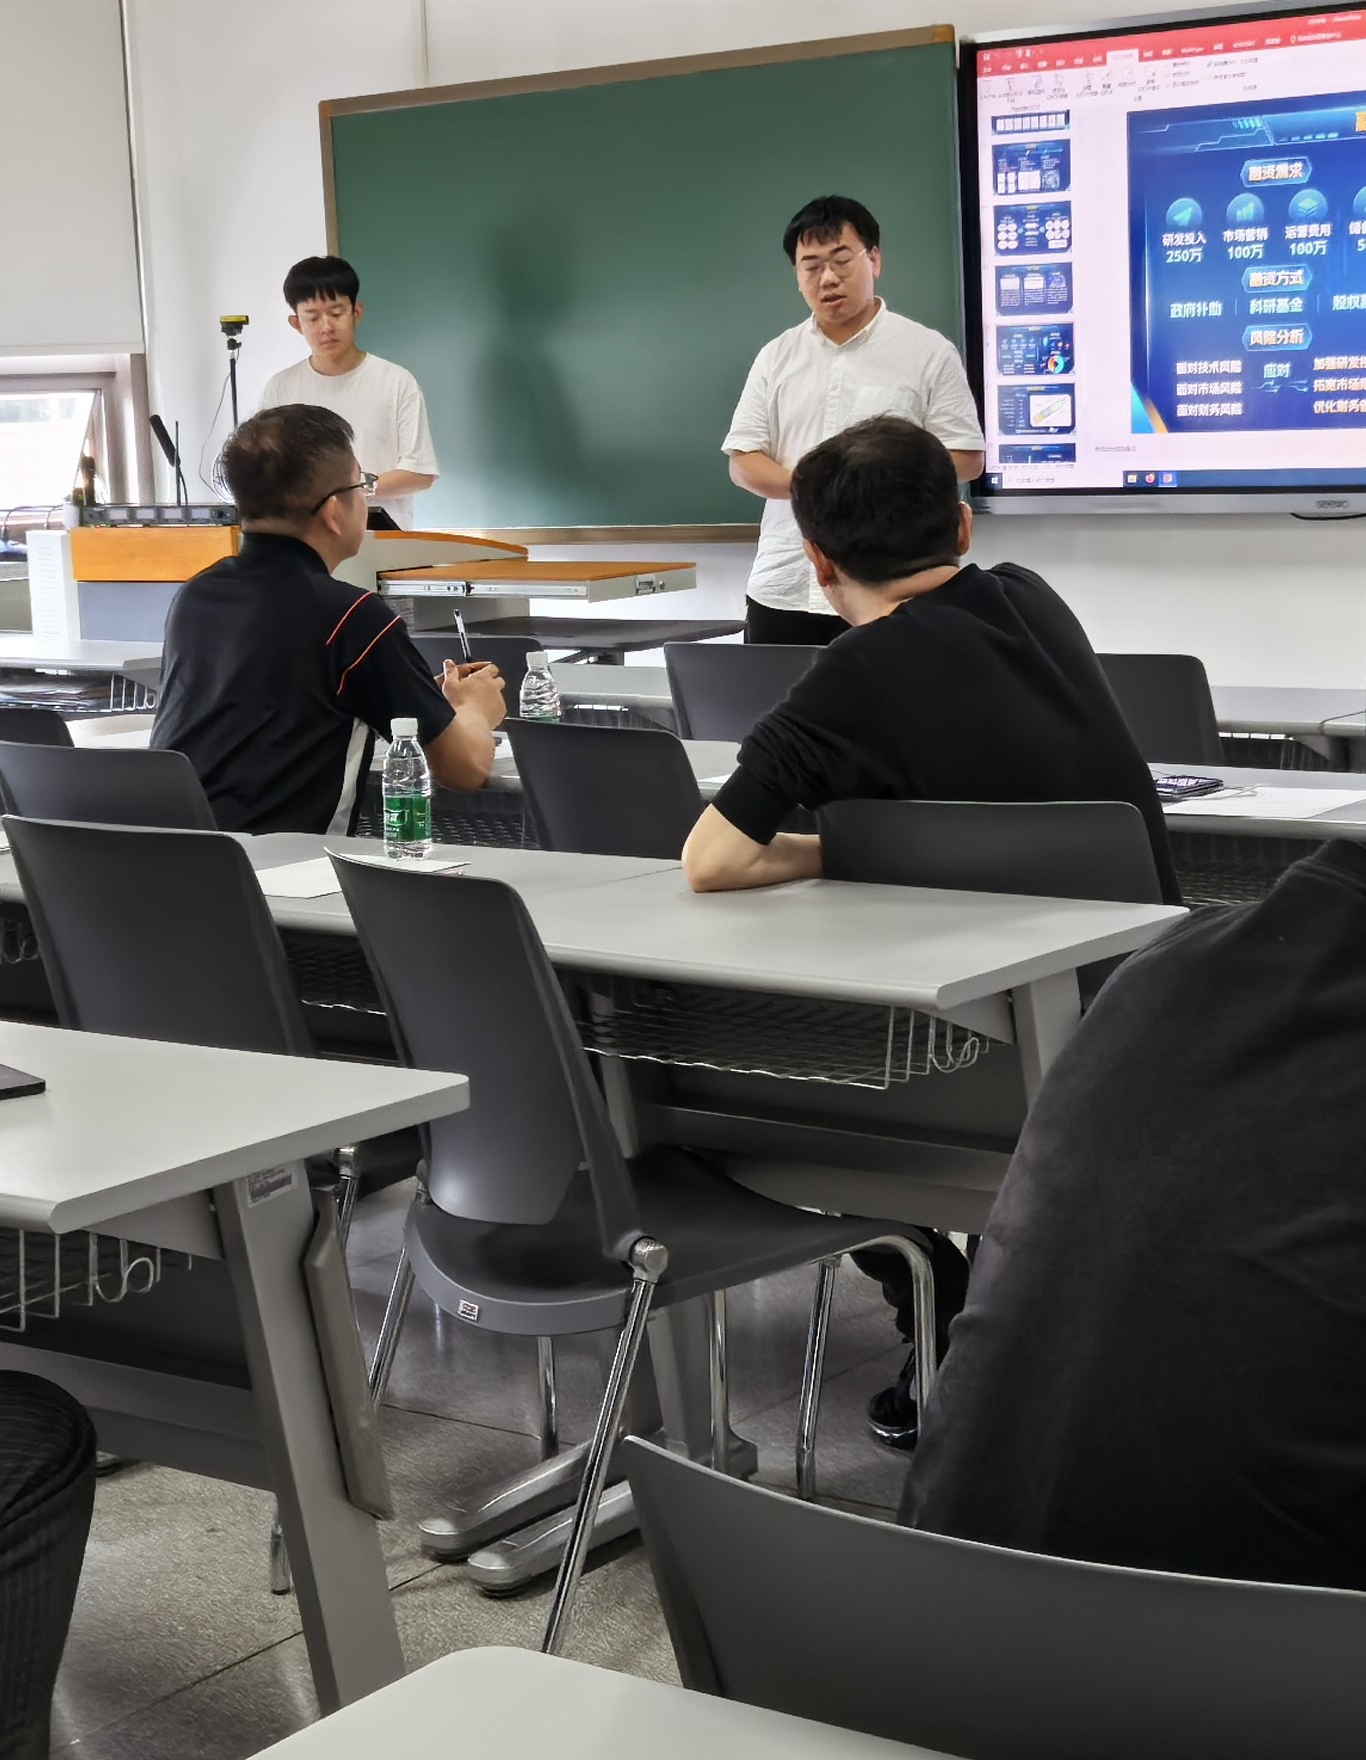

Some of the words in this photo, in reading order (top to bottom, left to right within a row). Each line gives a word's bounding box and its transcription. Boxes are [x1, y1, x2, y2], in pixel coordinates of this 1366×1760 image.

[1248, 161, 1303, 182] 融资需求
[1162, 233, 1206, 247] 研发投入
[1223, 227, 1268, 242] 市场营销
[1285, 224, 1331, 240] 运营费用
[1228, 244, 1264, 259] 100万
[1289, 240, 1327, 256] 100万
[1166, 249, 1202, 264] 250万
[1249, 270, 1304, 287] 融资方式
[1170, 301, 1222, 318] 政府补助
[1249, 298, 1303, 314] 科研基金
[1250, 328, 1304, 346] 风险分析
[1176, 360, 1242, 375] 面对技术风险
[1263, 362, 1291, 378] 应对
[1176, 381, 1242, 396] 面对市场风险
[1176, 402, 1242, 417] 面对财务风险
